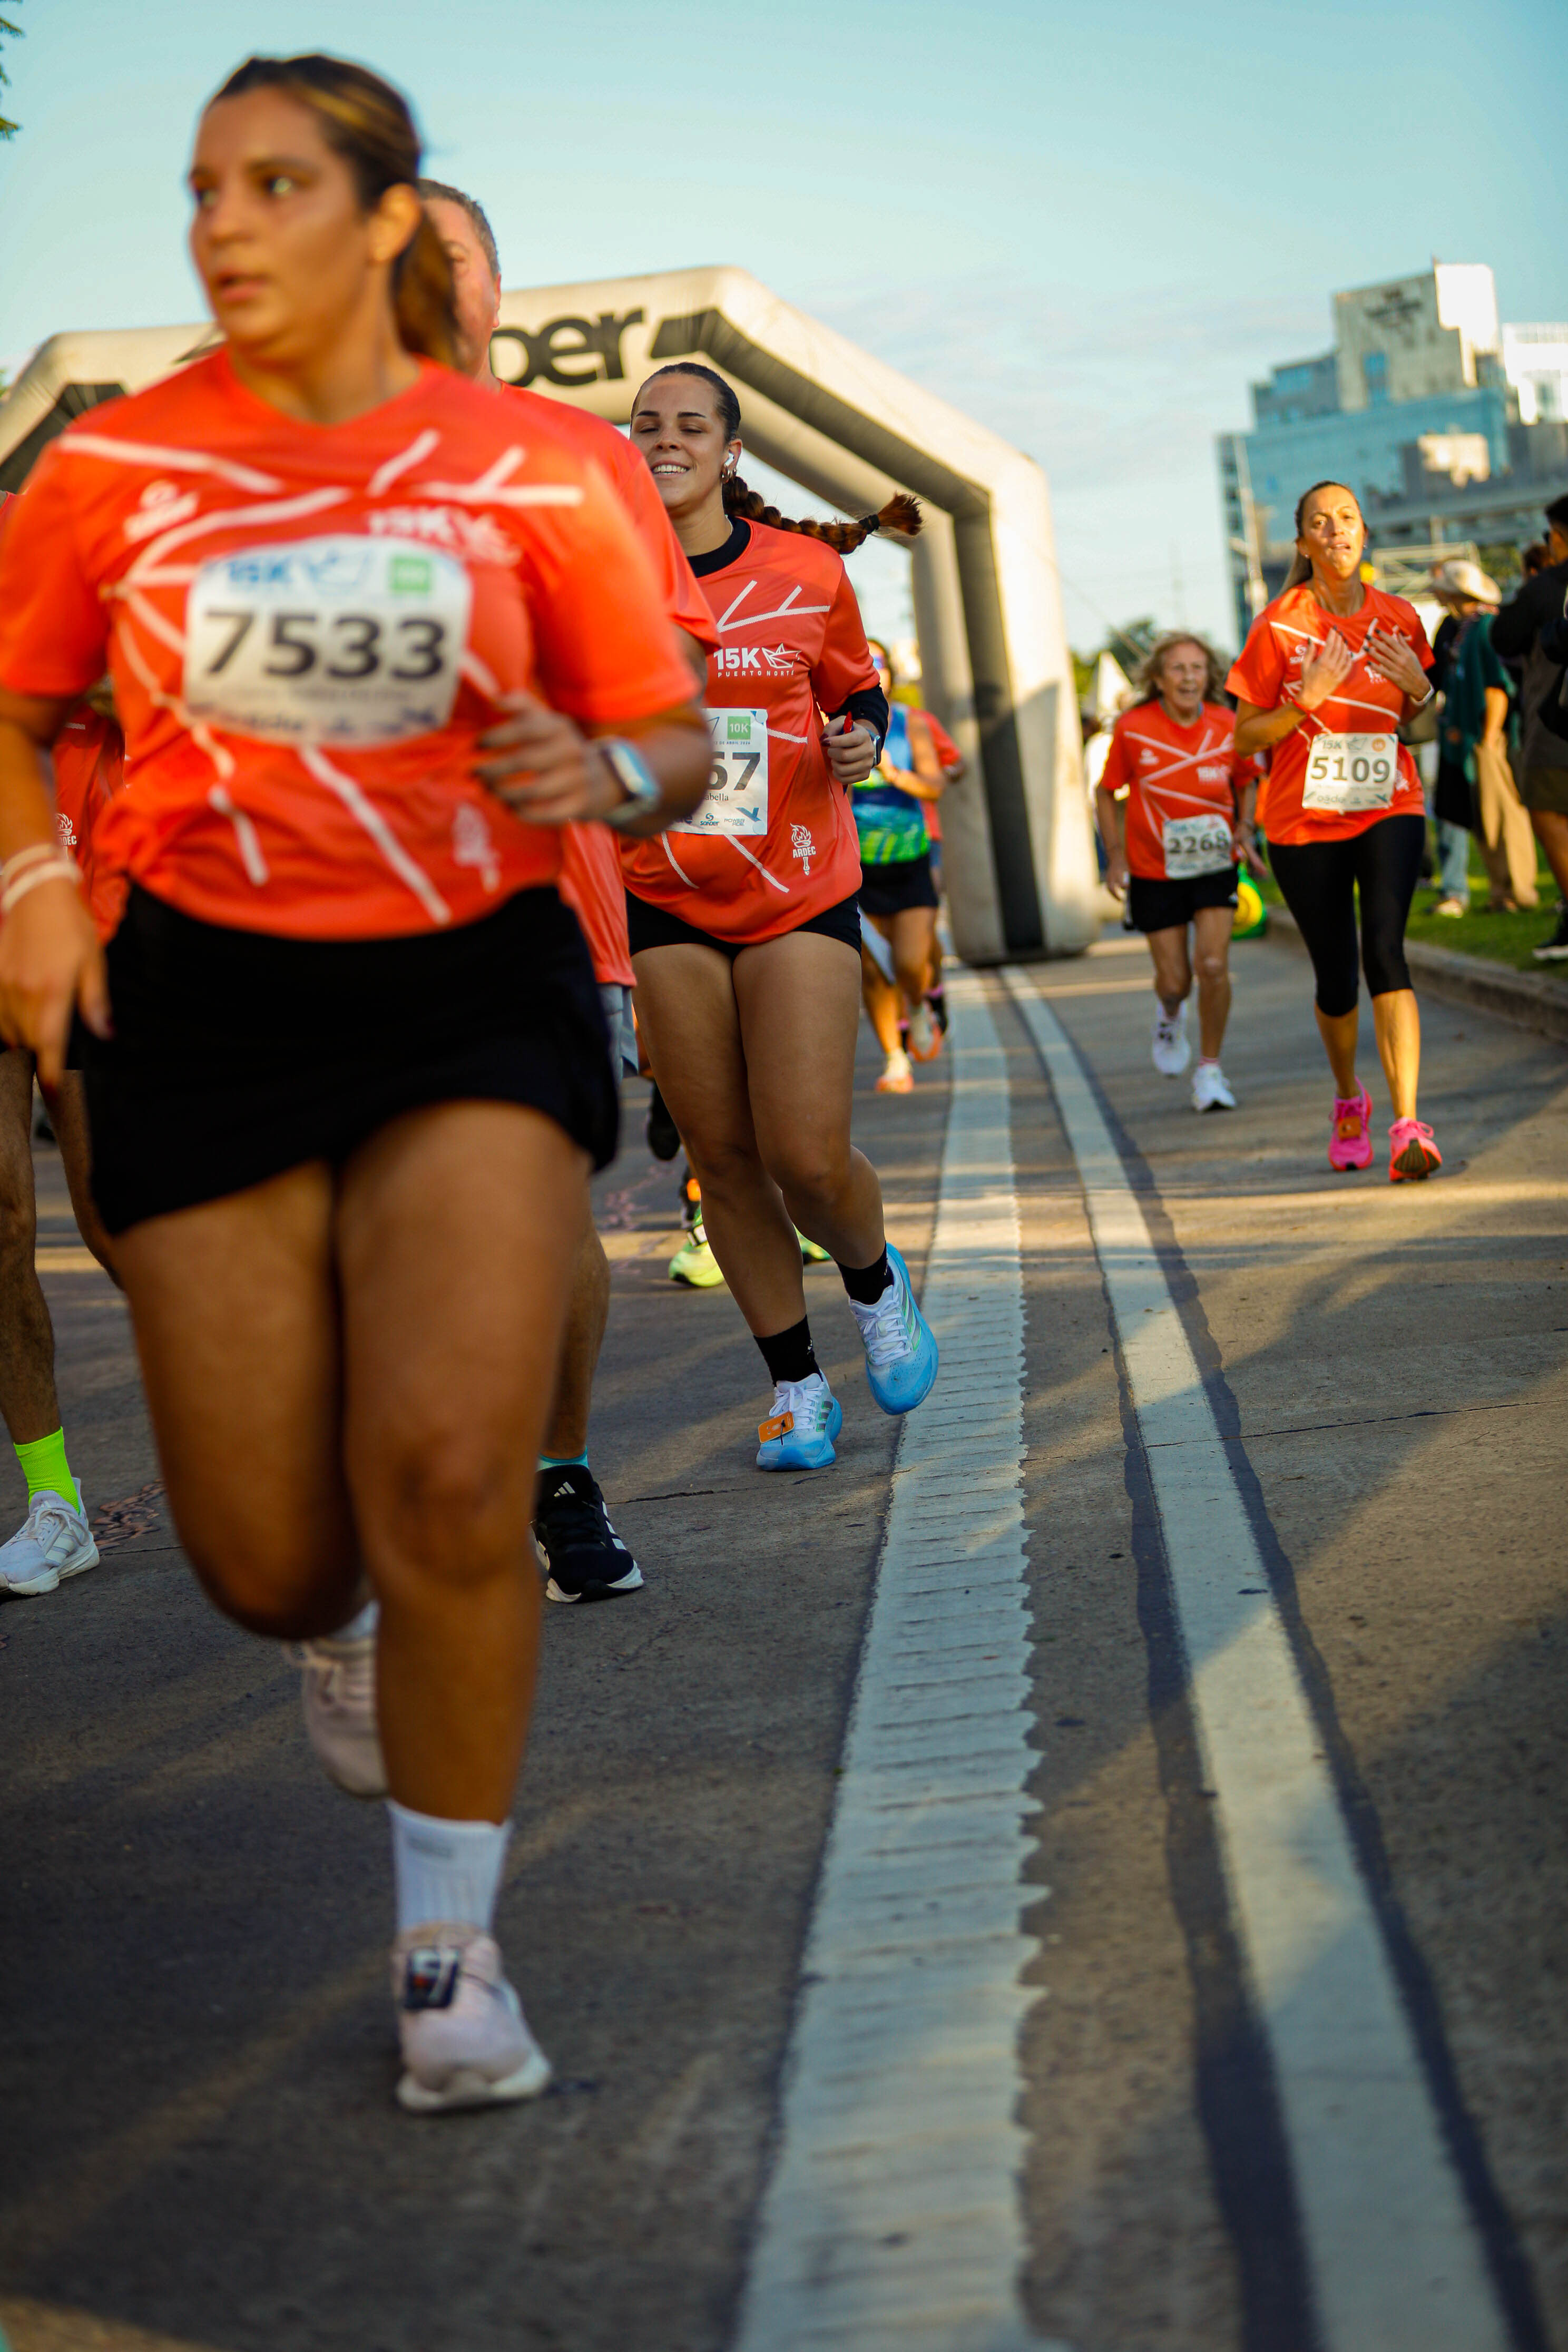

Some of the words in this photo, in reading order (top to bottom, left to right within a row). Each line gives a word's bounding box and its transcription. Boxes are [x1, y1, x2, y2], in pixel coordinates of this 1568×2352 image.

[206, 610, 446, 679] 7533
[713, 647, 761, 670] 15K
[730, 723, 748, 733] 10K
[1310, 756, 1390, 783] 5109
[59, 836, 77, 846] DEC
[792, 846, 816, 858] ARDEC
[1168, 830, 1230, 854] 2268
